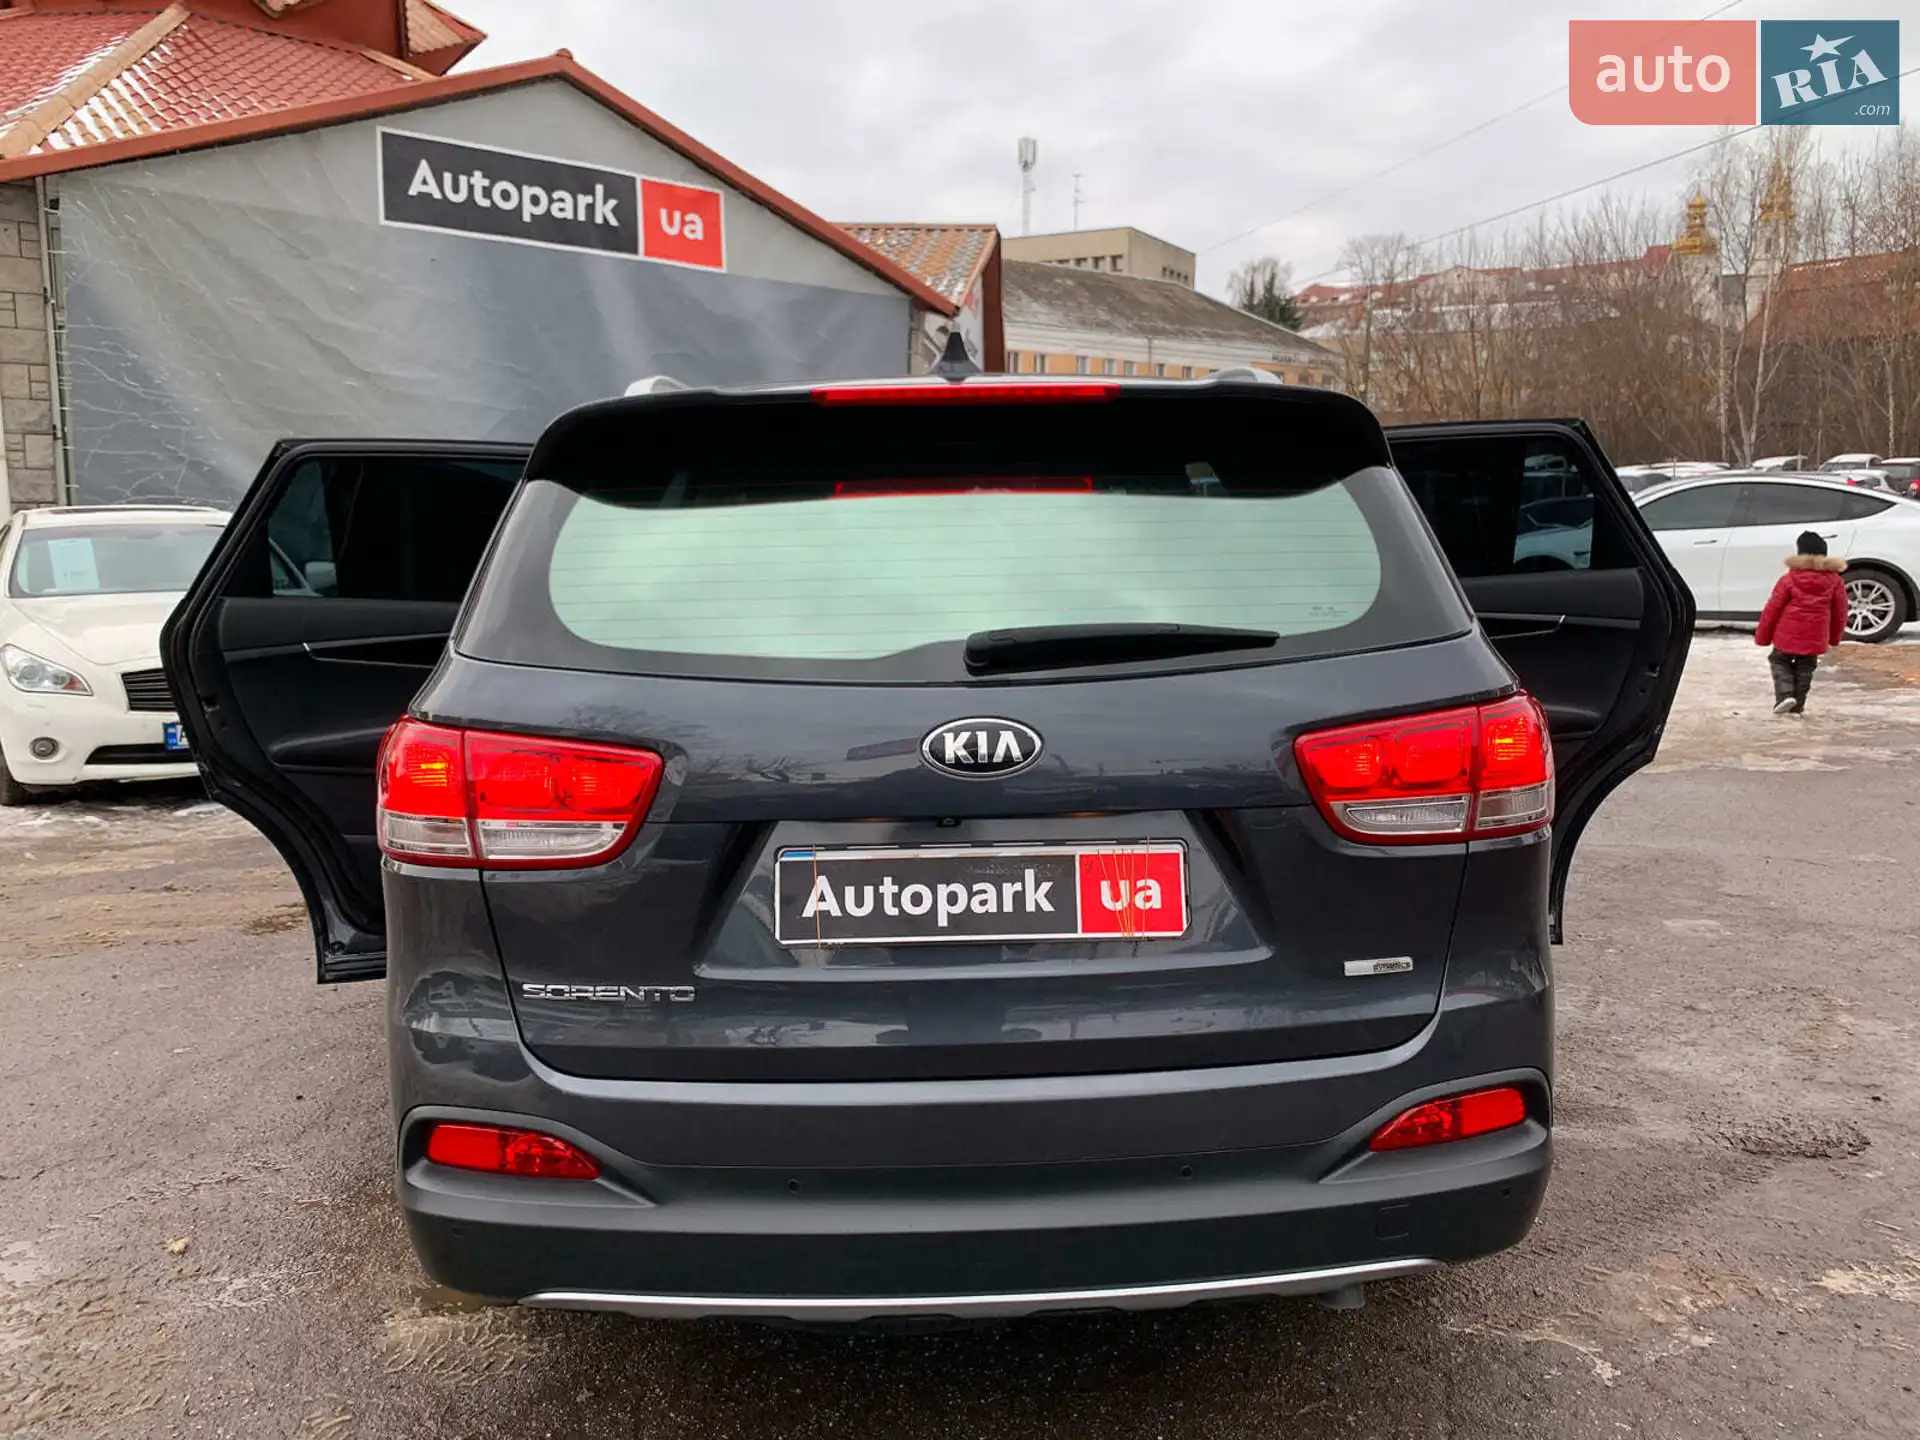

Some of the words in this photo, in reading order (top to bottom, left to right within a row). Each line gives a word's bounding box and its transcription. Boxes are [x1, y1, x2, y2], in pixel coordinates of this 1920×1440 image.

[408, 158, 620, 227] Autopark
[660, 207, 705, 241] ua
[942, 730, 1024, 764] KIA
[801, 868, 1056, 928] Autopark
[1100, 876, 1164, 911] ua
[522, 983, 696, 1003] SORENTO
